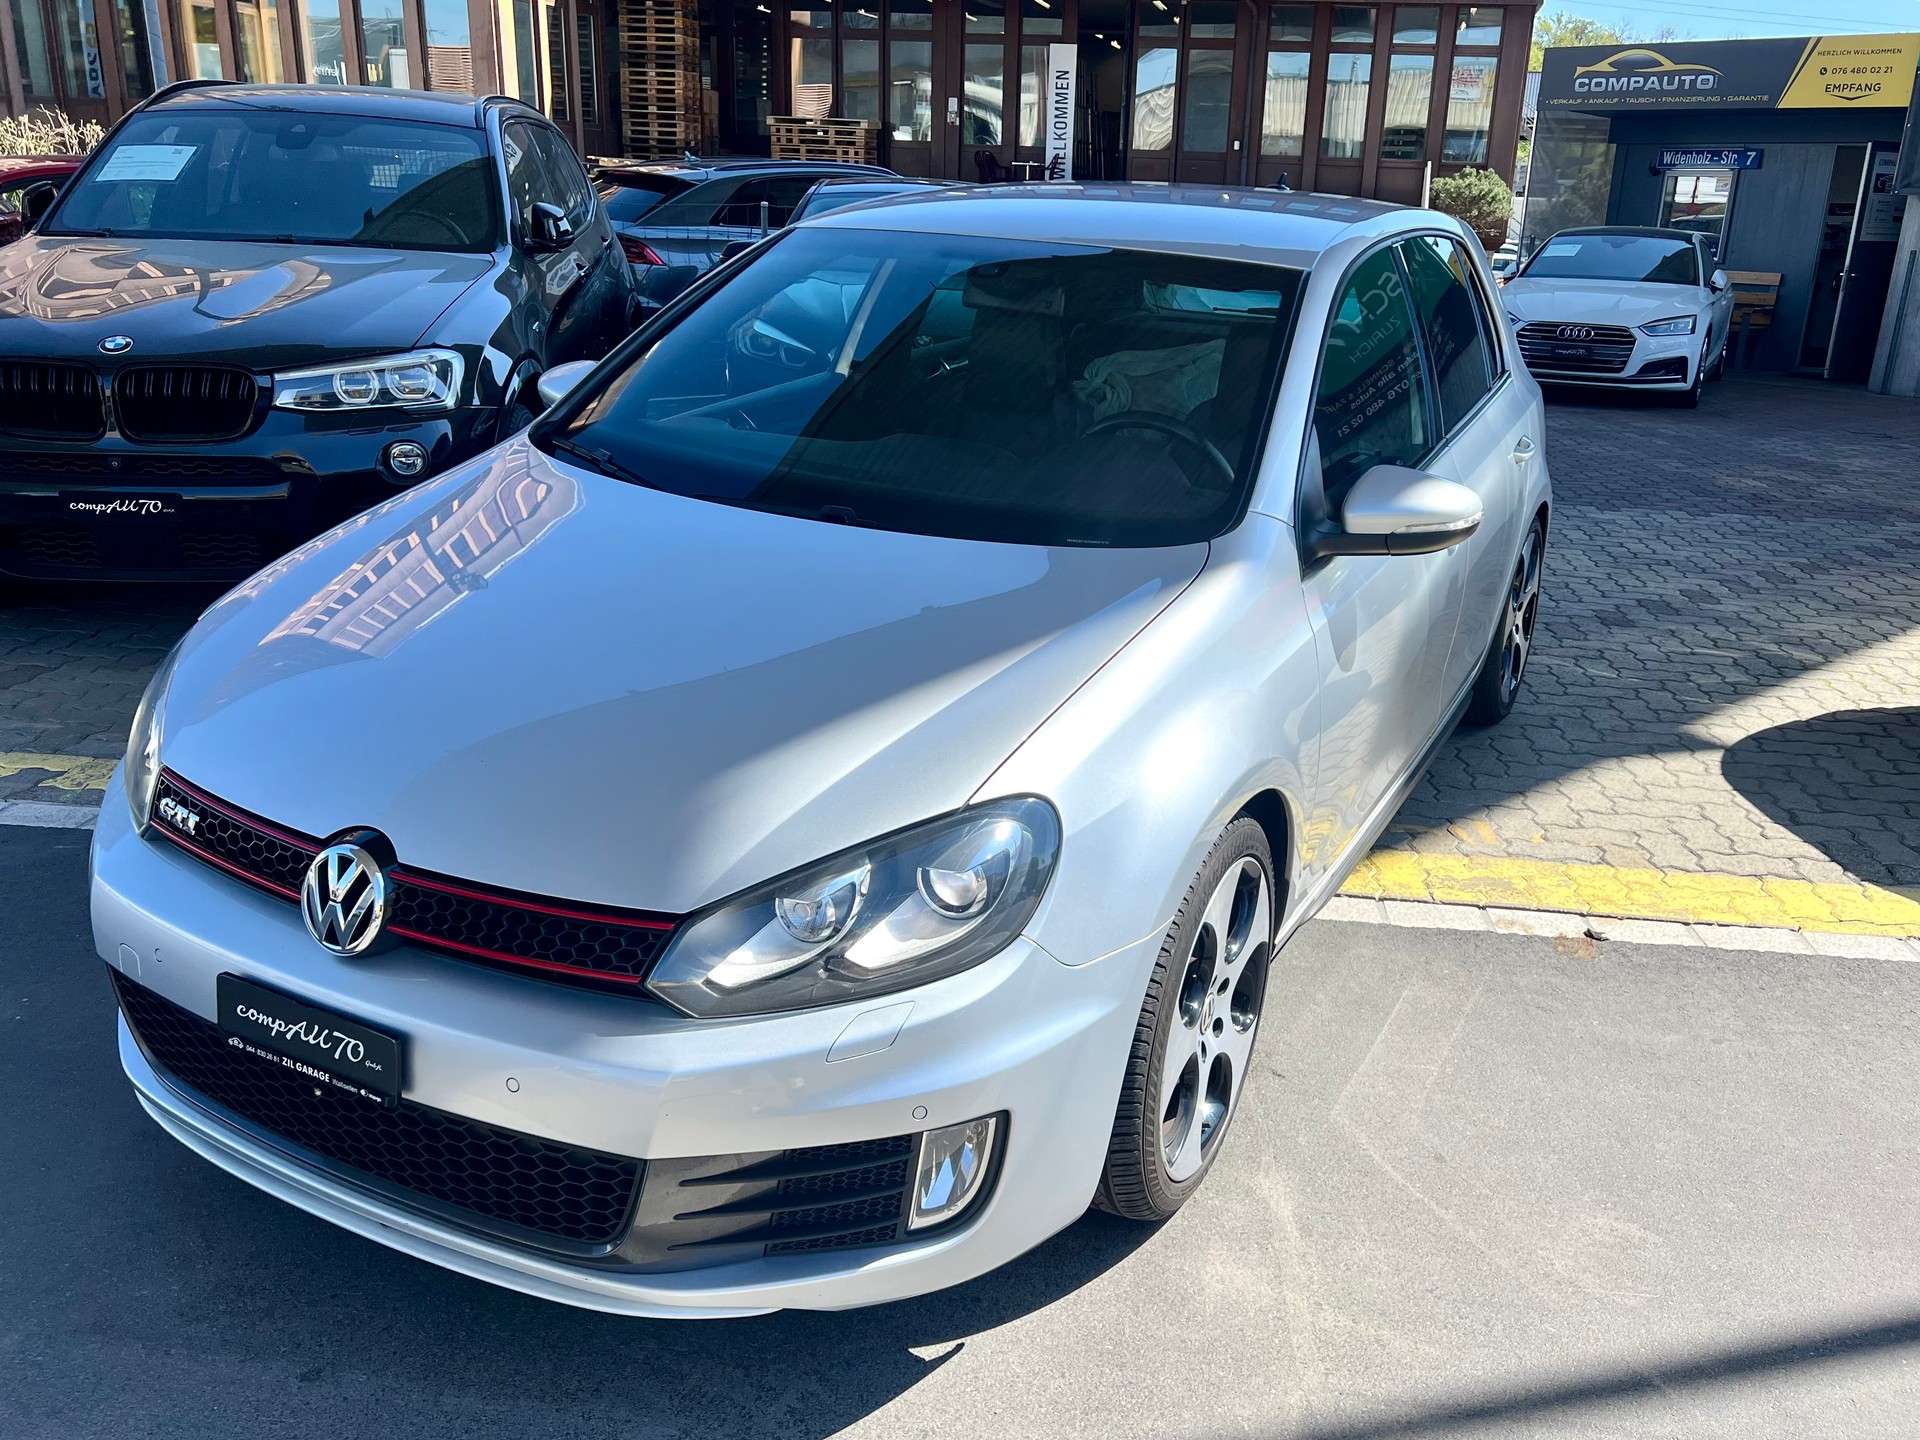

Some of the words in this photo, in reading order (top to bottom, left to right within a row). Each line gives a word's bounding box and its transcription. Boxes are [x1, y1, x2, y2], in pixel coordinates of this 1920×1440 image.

[1817, 49, 1852, 57] HERZLICH
[1853, 48, 1902, 56] WILLKOMMEN
[1831, 67, 1847, 75] 076
[1850, 66, 1868, 75] 480
[1870, 66, 1881, 74] 02
[1884, 66, 1893, 74] 21
[1574, 74, 1714, 93] COMPAUTO
[1824, 83, 1882, 93] EMPFANG
[1549, 98, 1583, 106] VERKAUF
[1662, 95, 1720, 104] FINANZIERUNG
[1727, 94, 1769, 102] GARANTIE
[1663, 151, 1711, 165] Widenholz
[1720, 151, 1738, 165] Str.
[1746, 151, 1757, 166] 7
[160, 797, 200, 836] GTI
[281, 1056, 295, 1070] ZIL
[295, 1062, 331, 1083] GARAGE
